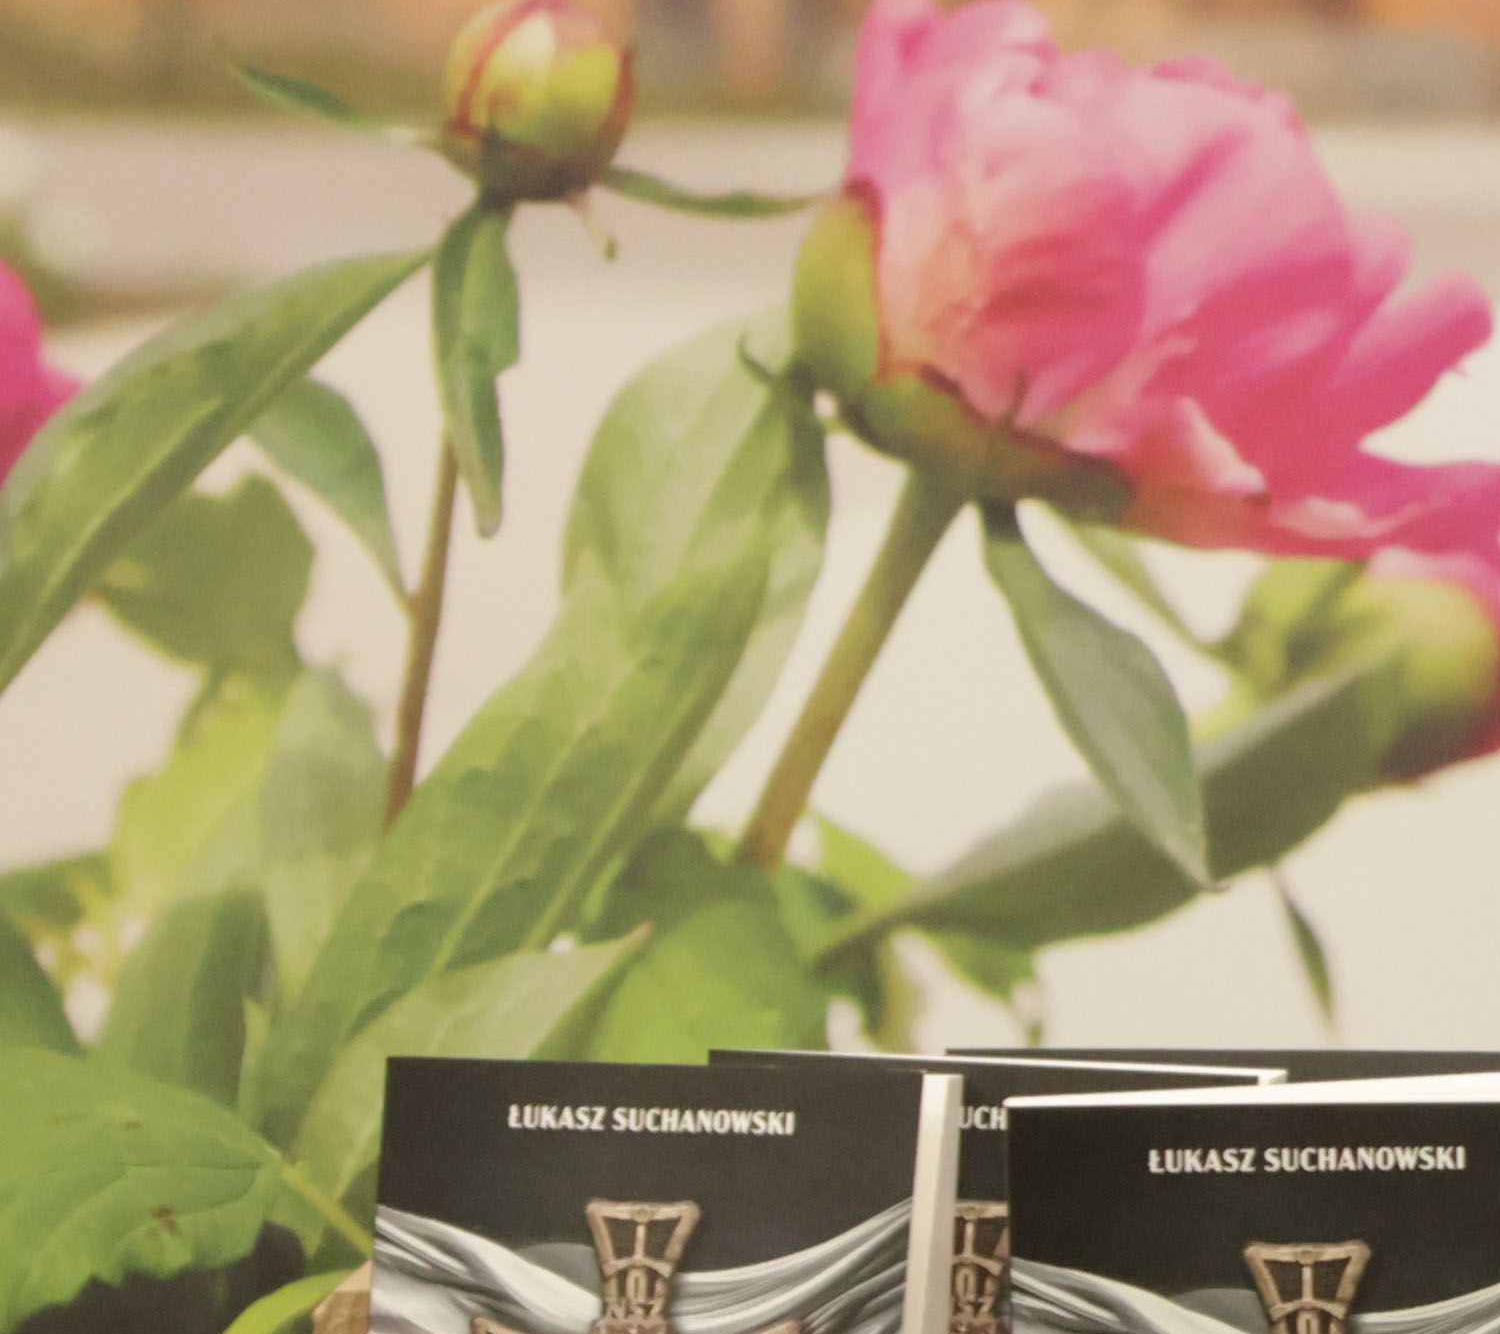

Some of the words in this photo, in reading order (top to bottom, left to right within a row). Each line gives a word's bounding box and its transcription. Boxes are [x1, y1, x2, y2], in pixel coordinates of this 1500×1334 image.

[507, 1103, 606, 1131] ŁUKASZ
[611, 1106, 797, 1136] SUCHANOWSKI
[1148, 1147, 1257, 1175] ŁUKASZ
[1262, 1144, 1468, 1174] SUCHANOWSKI
